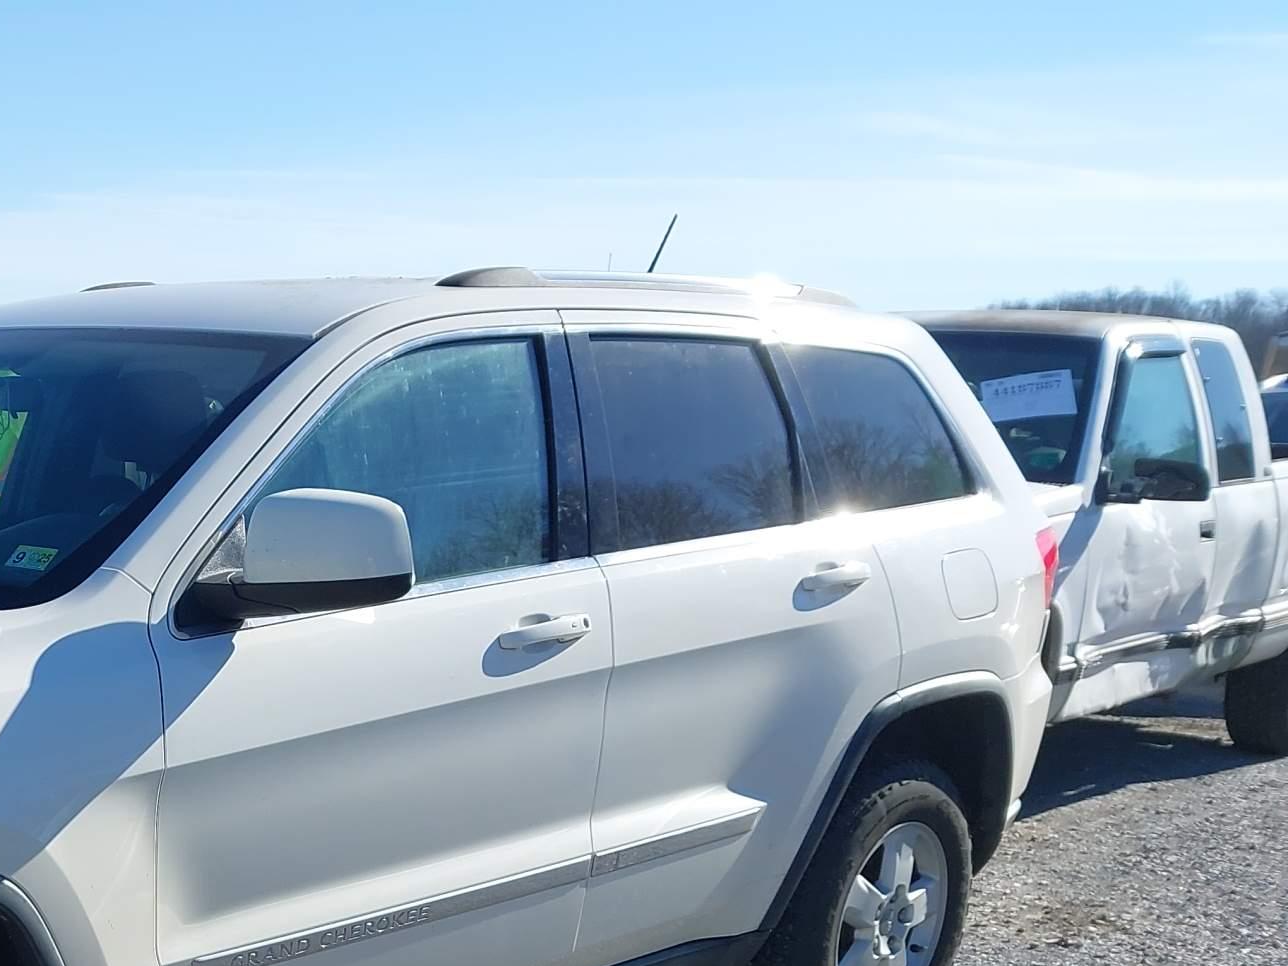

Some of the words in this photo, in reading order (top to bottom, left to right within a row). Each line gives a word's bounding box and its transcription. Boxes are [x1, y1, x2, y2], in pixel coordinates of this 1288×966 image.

[12, 551, 26, 563] 9
[39, 552, 53, 563] 25
[319, 905, 432, 950] CHEROKEE
